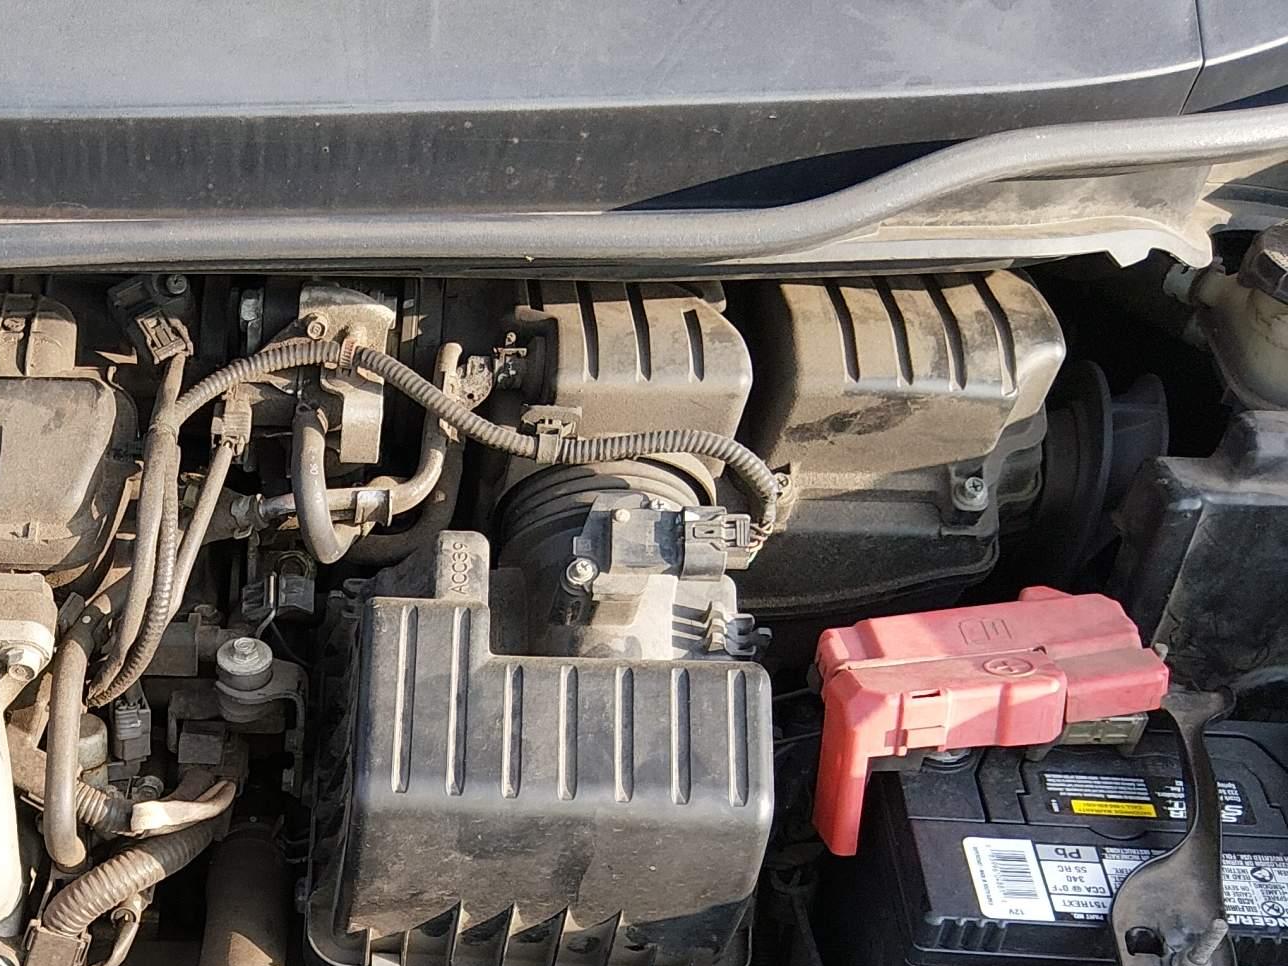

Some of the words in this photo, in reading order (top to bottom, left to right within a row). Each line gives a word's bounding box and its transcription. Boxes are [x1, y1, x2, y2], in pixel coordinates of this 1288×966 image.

[450, 542, 469, 595] ACC39
[1054, 848, 1082, 860] Pb
[1057, 864, 1072, 874] RC
[1065, 875, 1086, 884] 340
[1084, 885, 1107, 895] CCA
[1062, 899, 1108, 909] 151REXT
